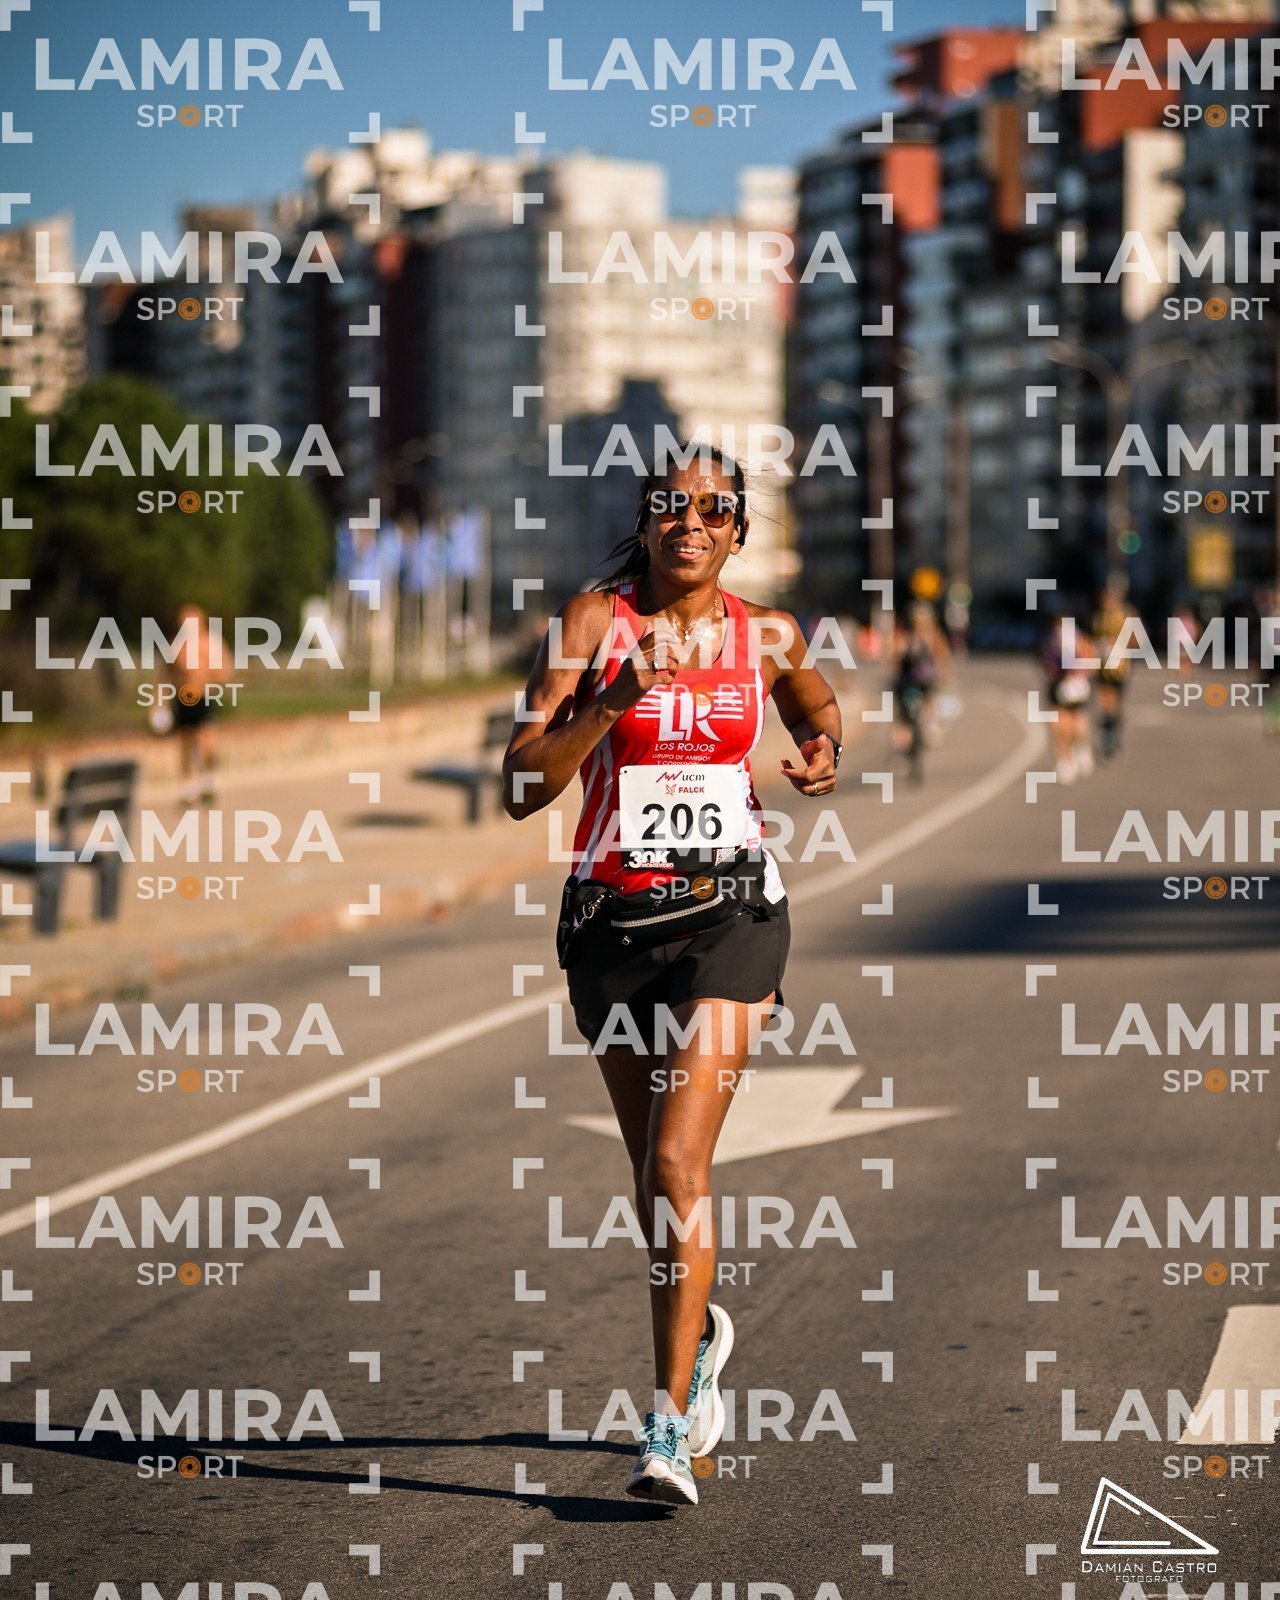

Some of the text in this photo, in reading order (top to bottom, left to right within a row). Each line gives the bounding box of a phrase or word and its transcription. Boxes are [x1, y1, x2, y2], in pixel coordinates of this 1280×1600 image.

[655, 743, 716, 753] LOS ROJOS
[682, 774, 705, 782] ucm
[678, 786, 705, 794] FALCK
[641, 803, 723, 841] 206
[629, 850, 671, 869] 30K
